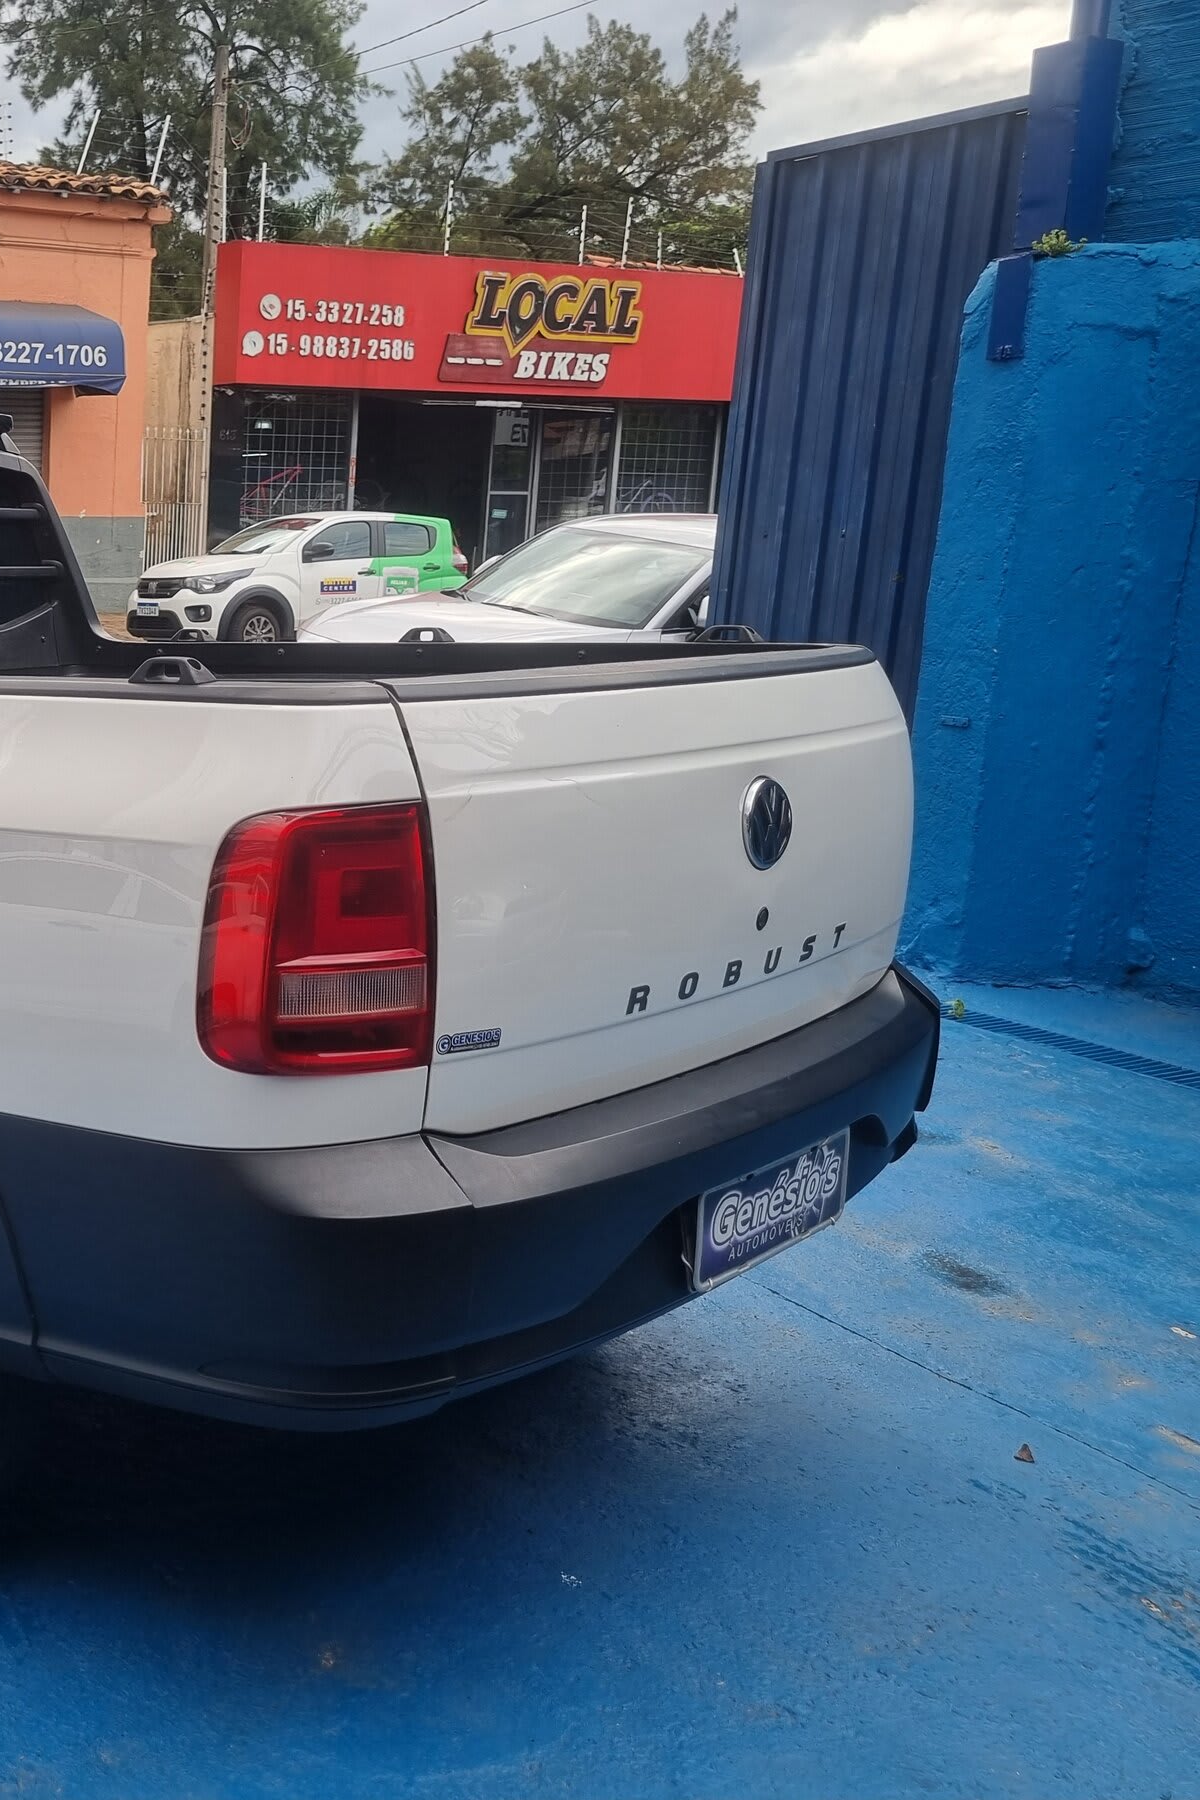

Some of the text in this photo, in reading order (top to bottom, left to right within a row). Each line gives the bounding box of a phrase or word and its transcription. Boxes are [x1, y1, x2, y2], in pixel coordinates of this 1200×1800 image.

[471, 276, 639, 345] LOCAL
[514, 350, 610, 382] BIKES
[625, 922, 847, 1016] ROBUST
[451, 1029, 501, 1047] GENESIO'S
